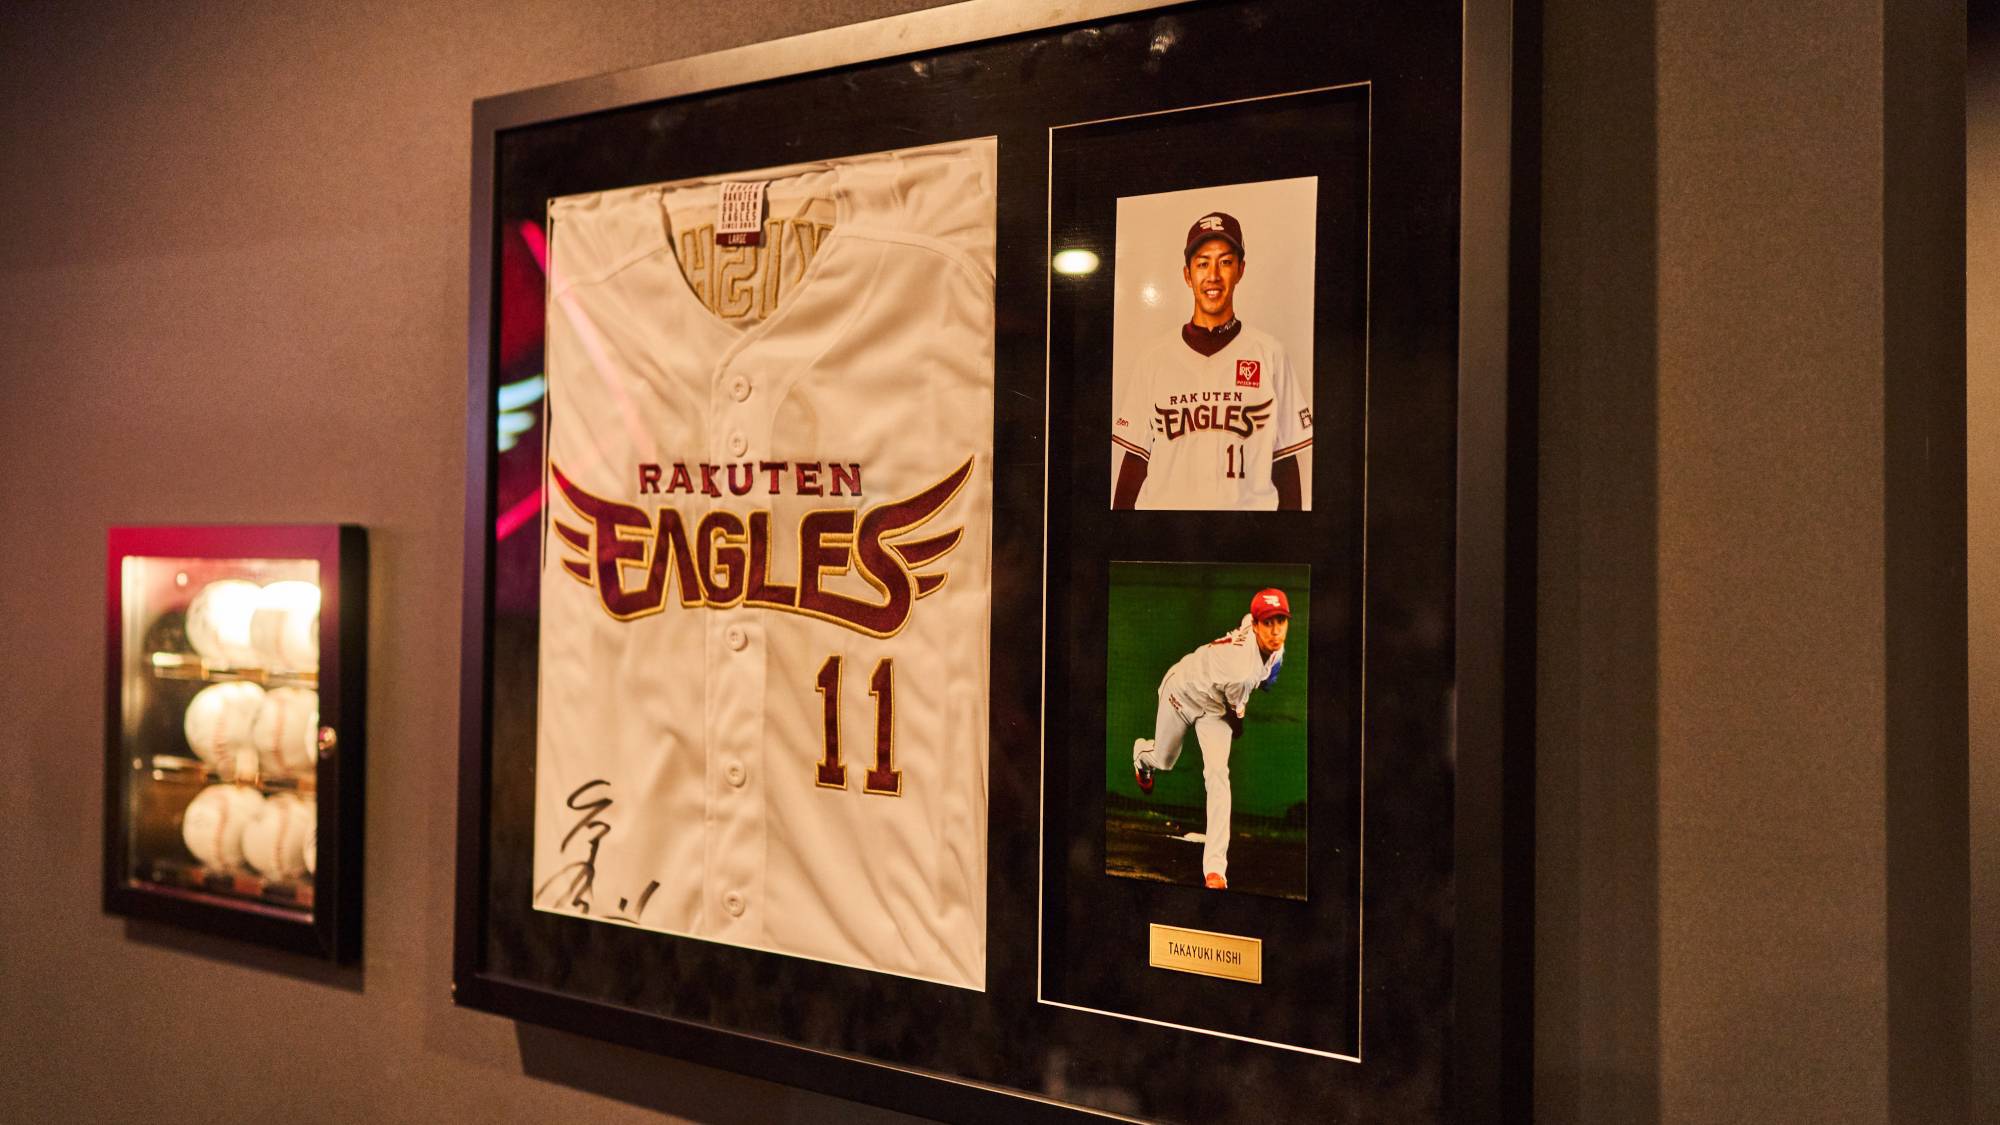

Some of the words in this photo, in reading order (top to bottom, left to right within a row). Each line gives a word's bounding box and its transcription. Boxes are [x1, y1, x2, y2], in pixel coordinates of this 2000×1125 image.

[723, 191, 758, 201] RAKUTEN
[723, 201, 757, 212] GOLDEN
[722, 211, 756, 222] EAGLES
[728, 233, 747, 245] LARGE
[1170, 391, 1243, 405] RAKUTEN
[1158, 400, 1265, 440] EAGLES
[1226, 443, 1246, 479] 11
[638, 462, 863, 498] RAKUTEN
[568, 476, 950, 639] EAGLES
[815, 655, 902, 797] 11
[1168, 941, 1213, 961] TAKAYUKI
[1216, 949, 1241, 965] KISHI
